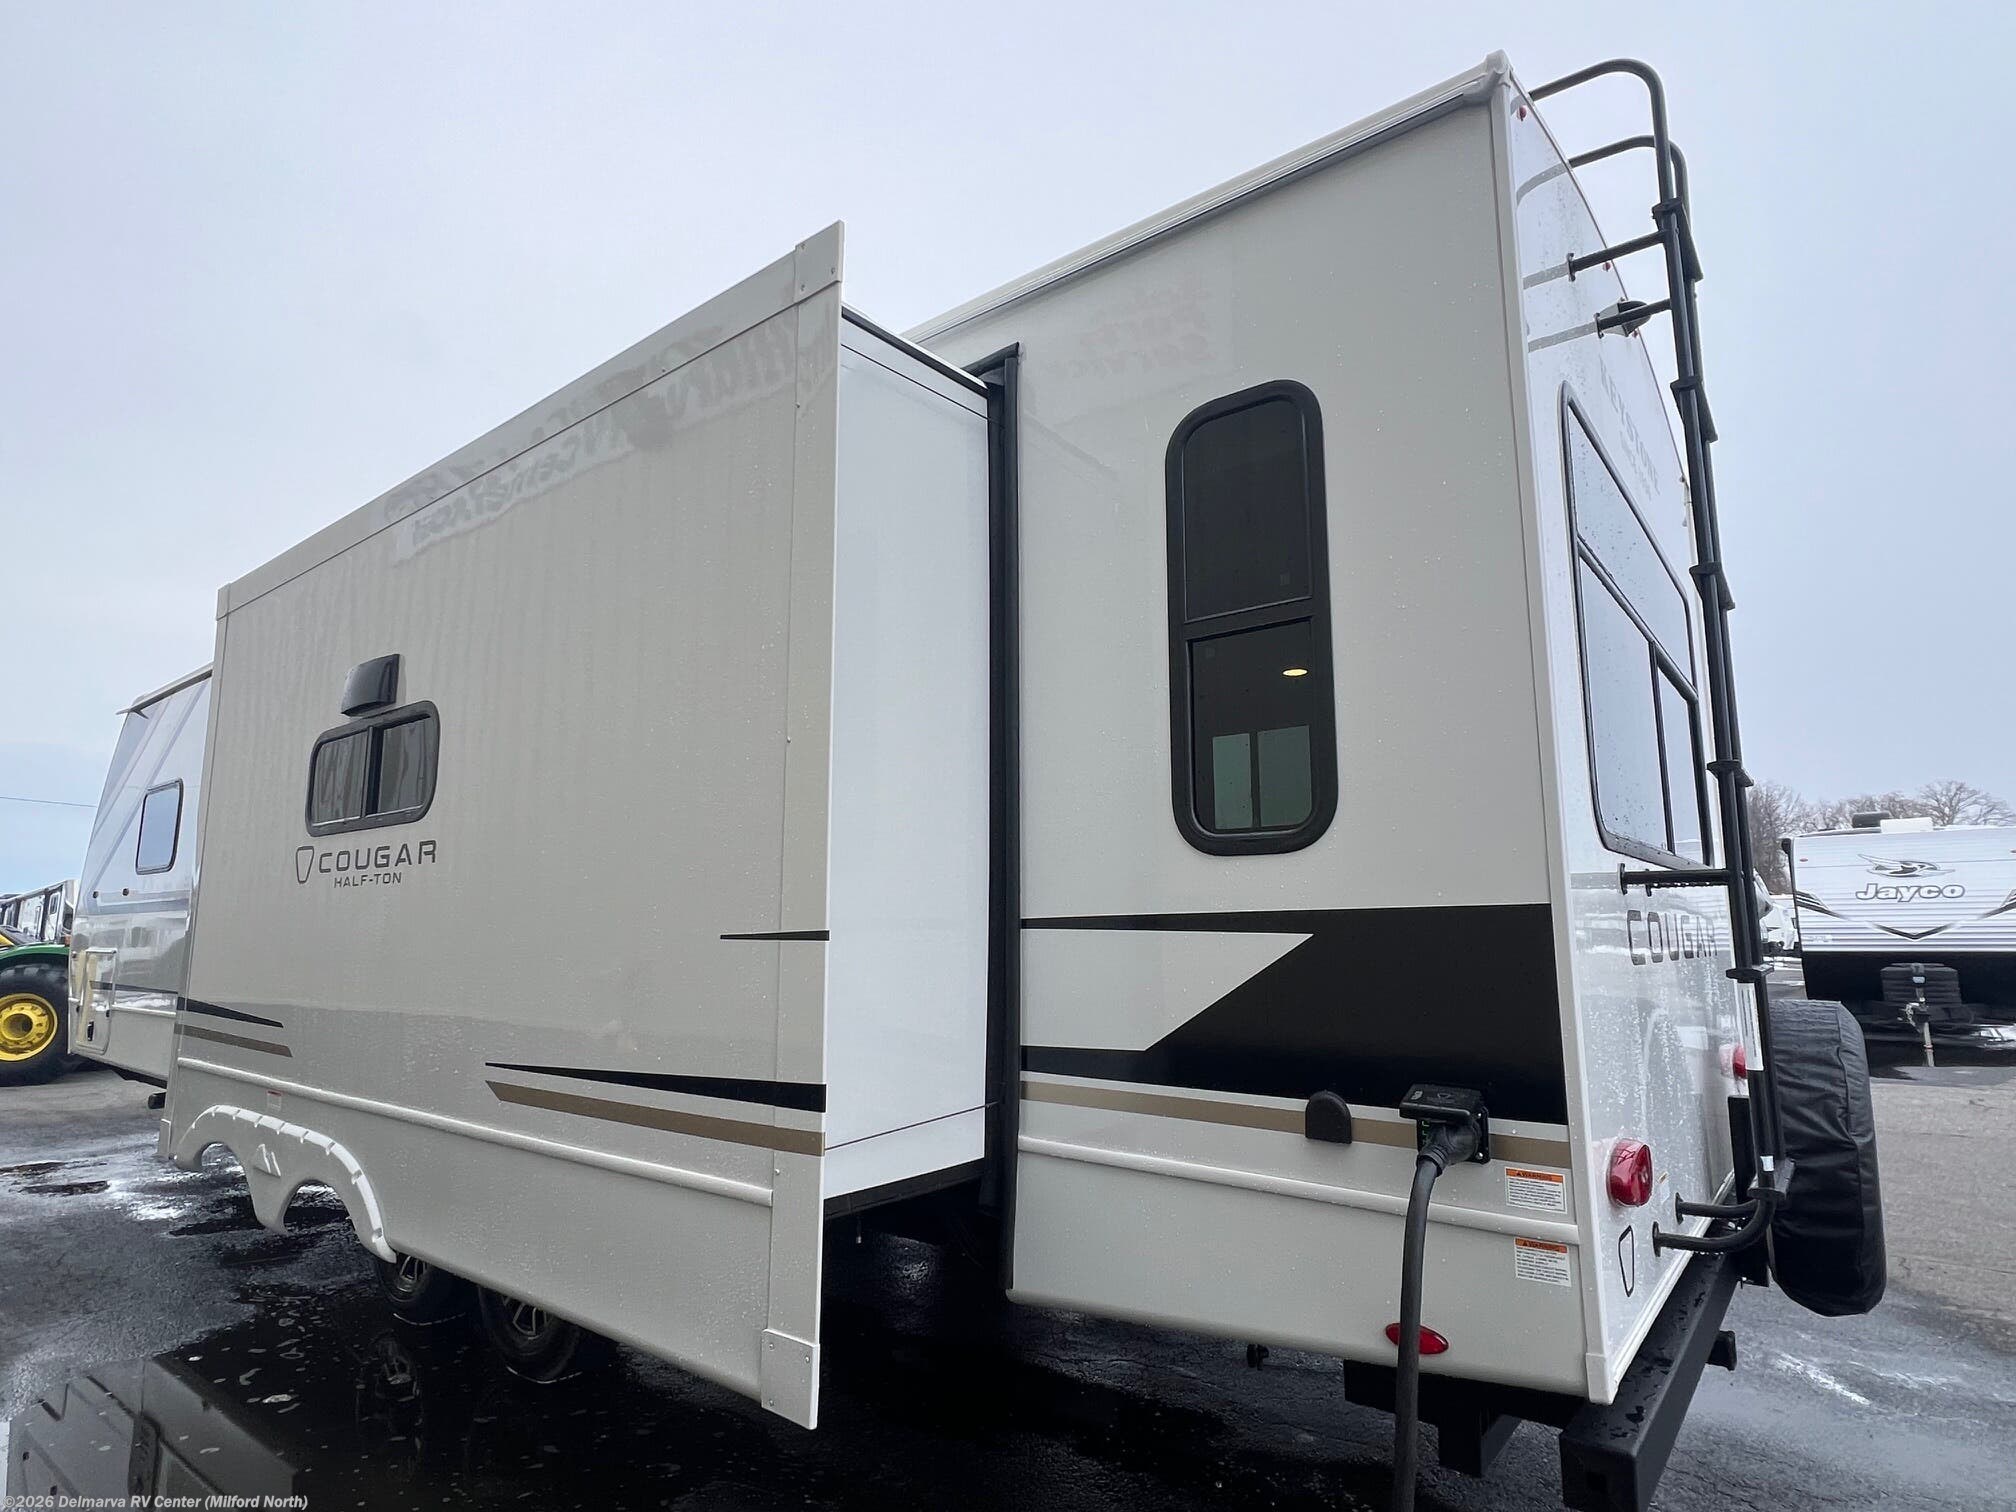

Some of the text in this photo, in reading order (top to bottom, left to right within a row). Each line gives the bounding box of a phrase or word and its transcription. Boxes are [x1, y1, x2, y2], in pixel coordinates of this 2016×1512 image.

[318, 839, 437, 874] COUGAR
[333, 872, 402, 889] HALF-TON
[1855, 882, 1966, 903] Jayco
[1626, 909, 1718, 966] COUGAR
